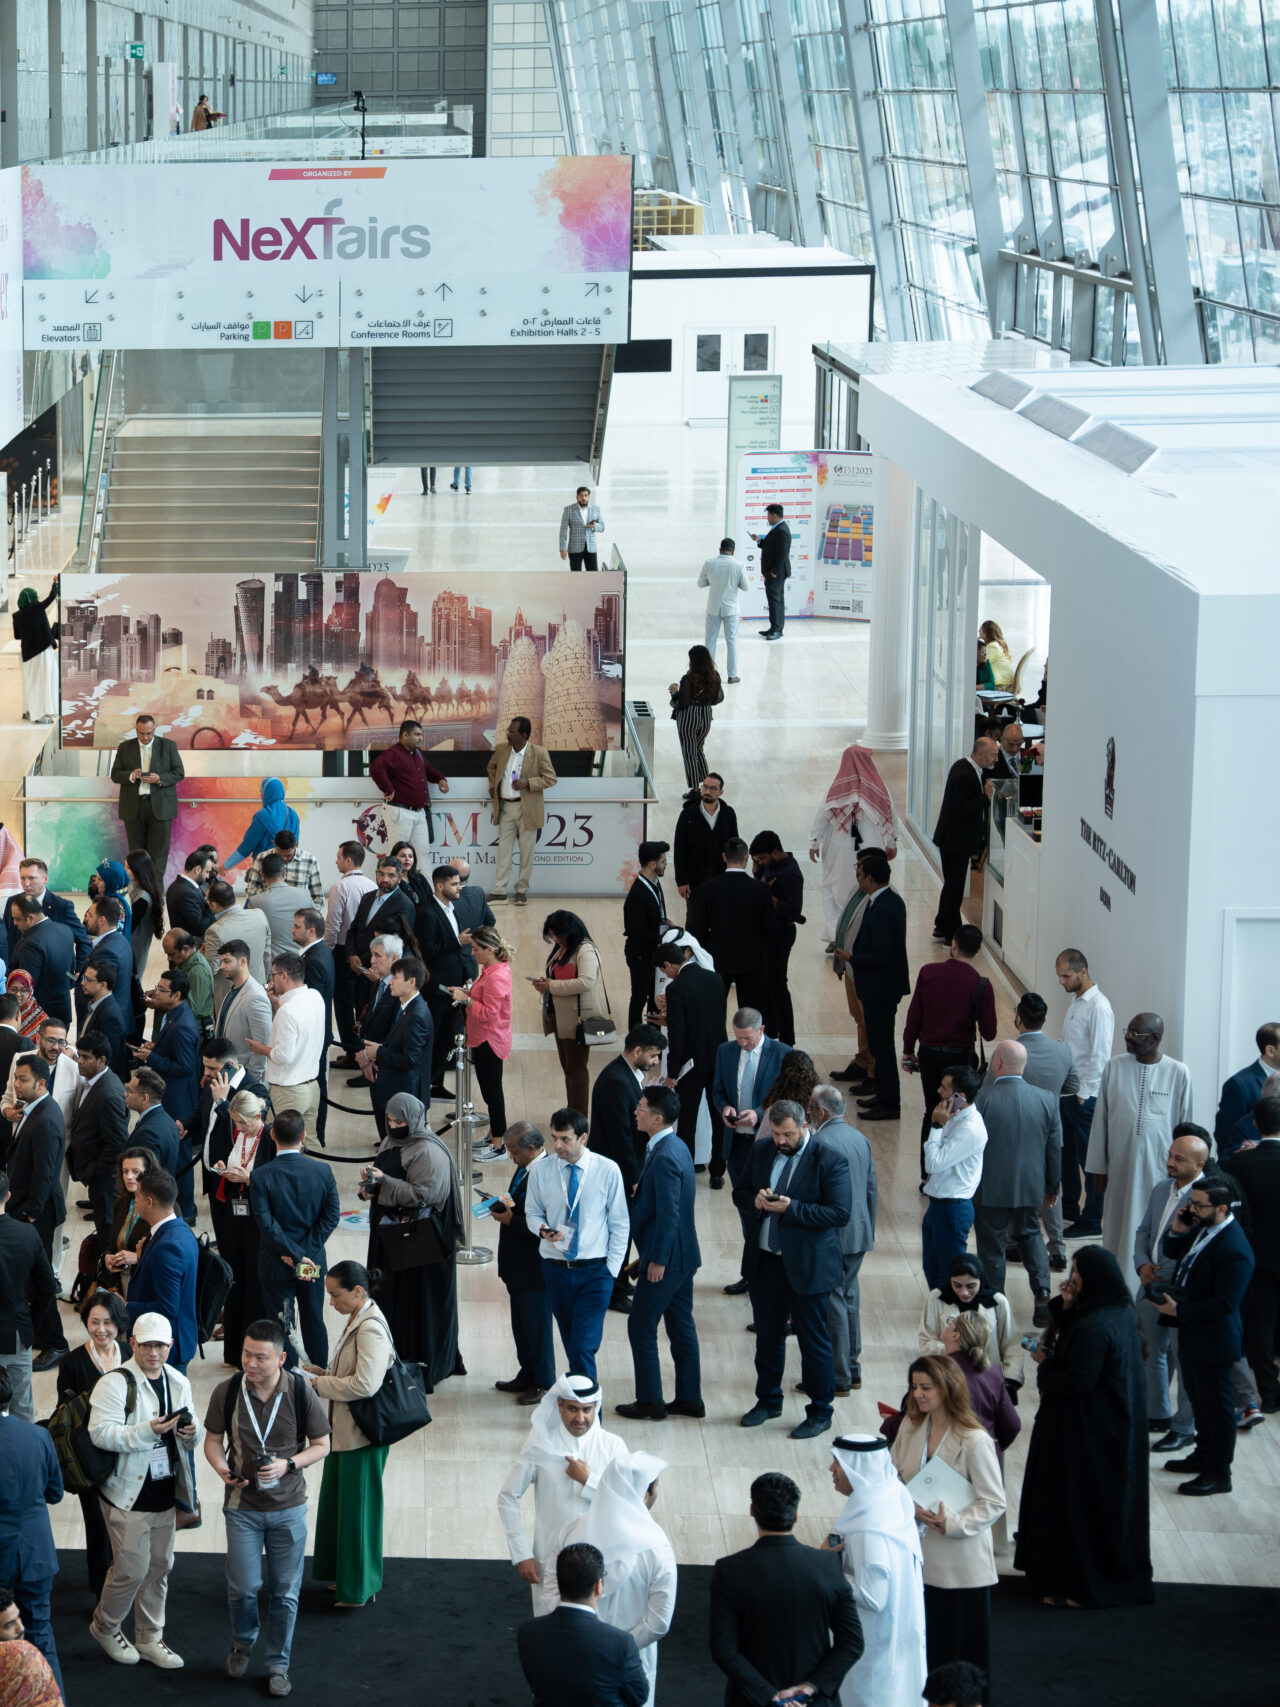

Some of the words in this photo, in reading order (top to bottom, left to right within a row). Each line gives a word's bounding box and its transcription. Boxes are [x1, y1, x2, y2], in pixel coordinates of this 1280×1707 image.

[191, 321, 221, 332] السيارات
[223, 321, 250, 331] مواقف
[220, 332, 250, 342] Parking
[351, 330, 400, 339] Conference
[402, 330, 431, 338] Rooms
[510, 328, 555, 337] Exhibition
[557, 328, 578, 336] Halls
[581, 328, 587, 336] 2
[595, 328, 601, 336] 5
[41, 334, 81, 342] Elevators
[1080, 817, 1092, 847] THE
[1092, 830, 1136, 896] RITZ-CARLTON
